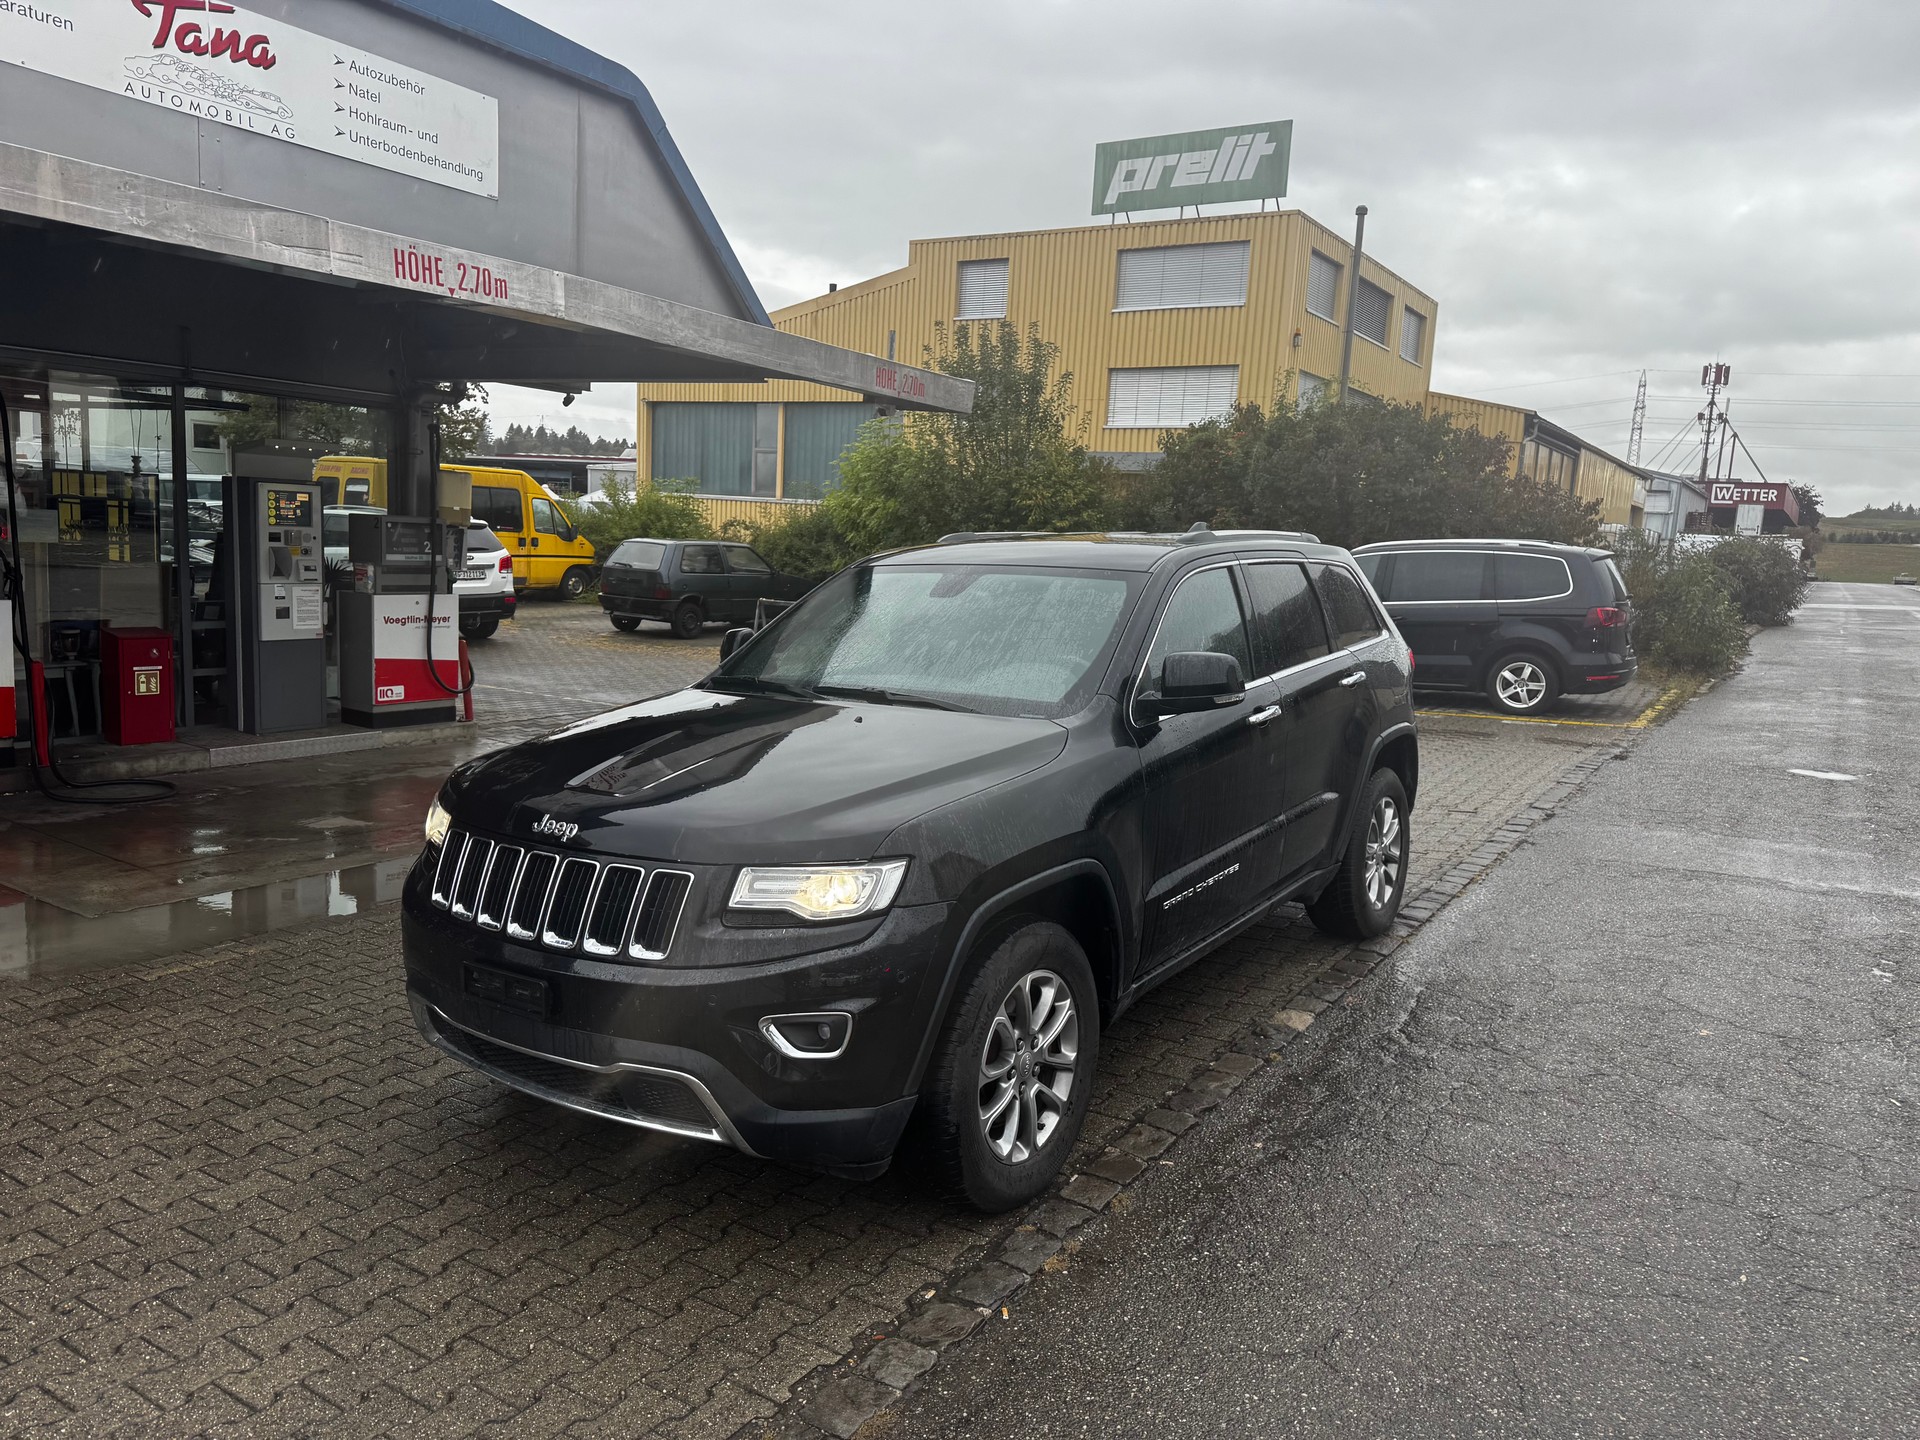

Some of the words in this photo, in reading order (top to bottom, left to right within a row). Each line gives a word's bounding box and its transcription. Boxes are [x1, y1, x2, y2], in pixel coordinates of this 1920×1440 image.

[131, 0, 277, 70] Tana
[349, 60, 426, 96] Autozubehör
[349, 83, 381, 104] Natel
[124, 82, 255, 129] AUTOMOBIL
[271, 124, 296, 140] AG
[349, 106, 414, 135] Hohlraum-
[417, 130, 439, 144] und
[349, 130, 484, 182] Unterbodenbehandlung
[1104, 132, 1277, 205] prelit
[394, 245, 445, 287] HÖHE
[1714, 485, 1778, 503] WETTER
[423, 541, 432, 553] 2
[531, 813, 579, 843] Jeep
